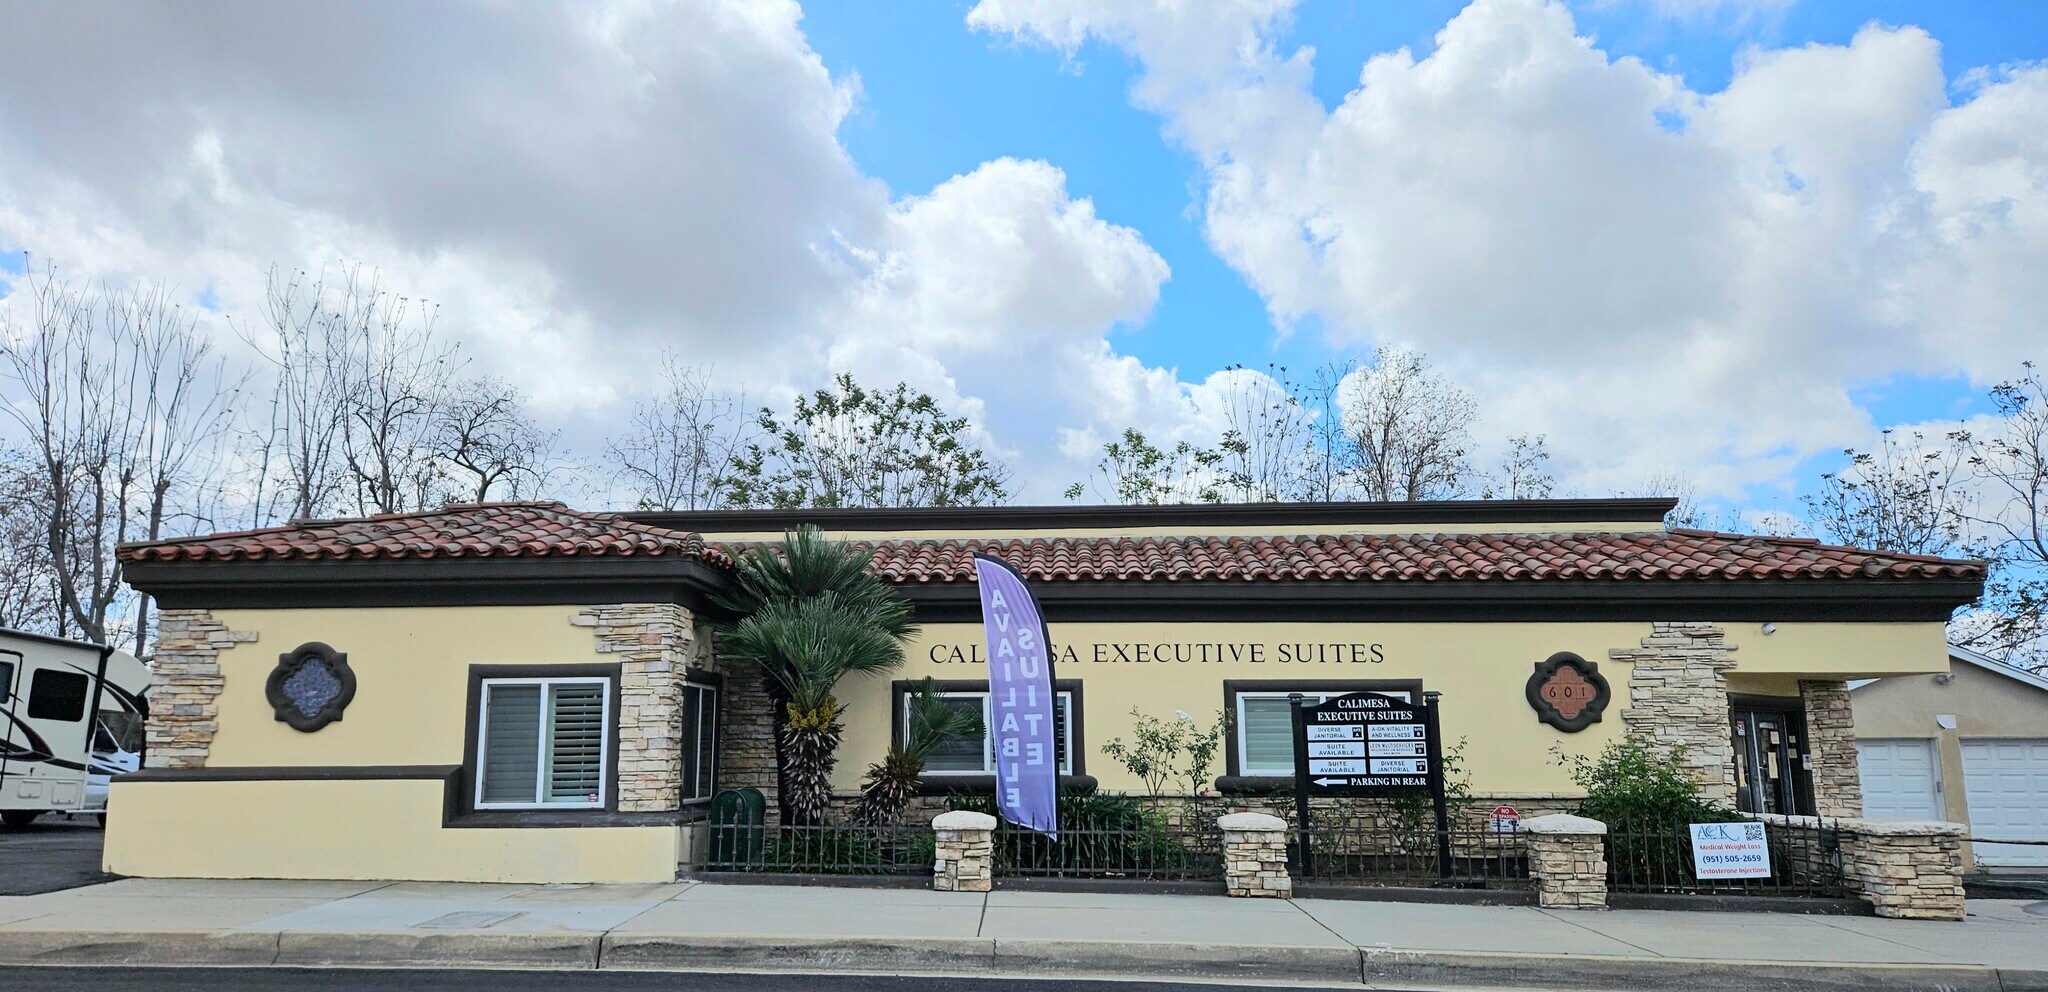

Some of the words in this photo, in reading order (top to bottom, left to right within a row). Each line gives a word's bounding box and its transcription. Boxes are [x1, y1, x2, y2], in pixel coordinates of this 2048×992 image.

[1092, 643, 1266, 663] EXECUTIVE
[1278, 643, 1384, 663] SUITES
[1549, 686, 1585, 698] 601
[1337, 699, 1390, 709] CALIMESA
[1317, 711, 1375, 721] EXECUTIVE
[1377, 711, 1413, 720] SUITES
[1350, 777, 1390, 786] PARKING
[1391, 777, 1401, 786] IN
[1402, 777, 1427, 786] REAR
[1725, 843, 1747, 851] Weight
[1702, 855, 1723, 864] (951)
[1724, 854, 1762, 862] 505-2659
